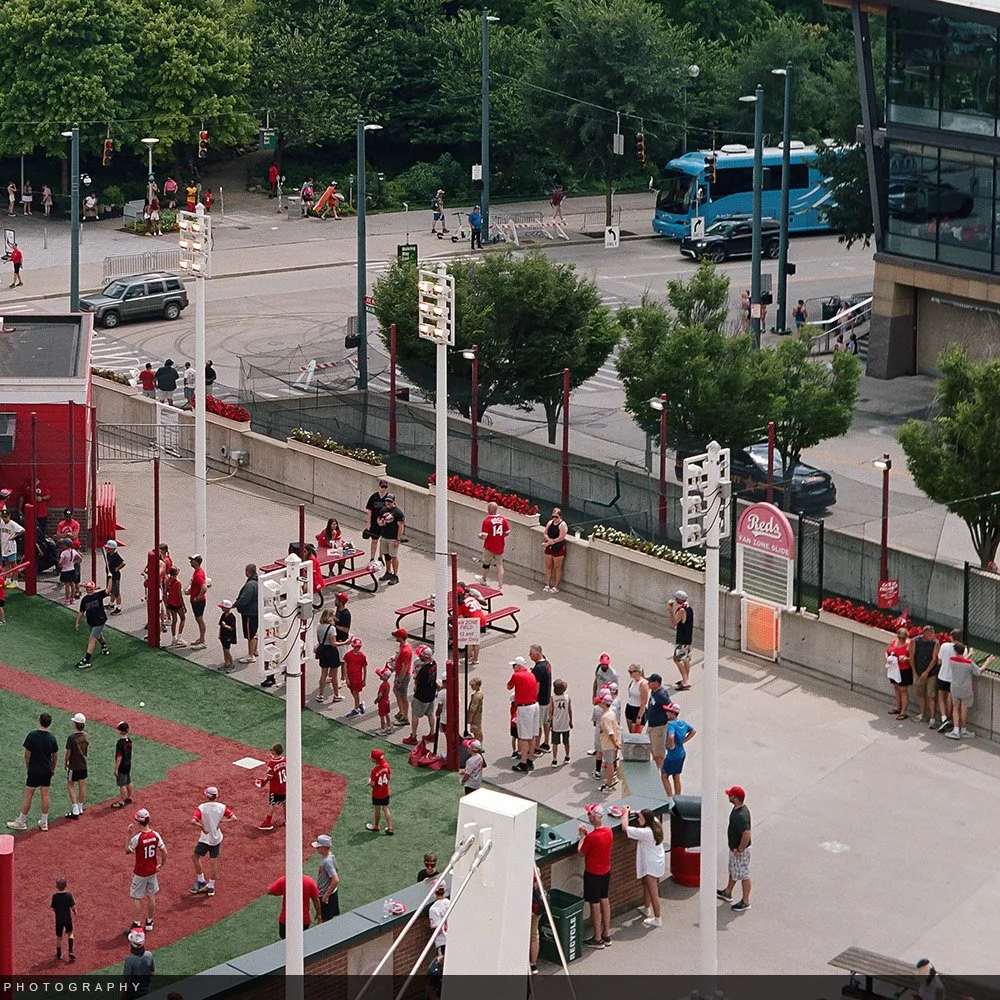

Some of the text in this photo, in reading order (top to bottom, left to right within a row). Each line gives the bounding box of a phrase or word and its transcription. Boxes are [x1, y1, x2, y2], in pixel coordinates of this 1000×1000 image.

[492, 524, 504, 537] 14
[747, 513, 782, 540] Reds
[739, 535, 790, 557] FAN ZONE SLIDE
[557, 701, 566, 710] 44
[377, 773, 388, 786] 44
[144, 844, 156, 859] 16
[569, 916, 577, 961] RECYCLE
